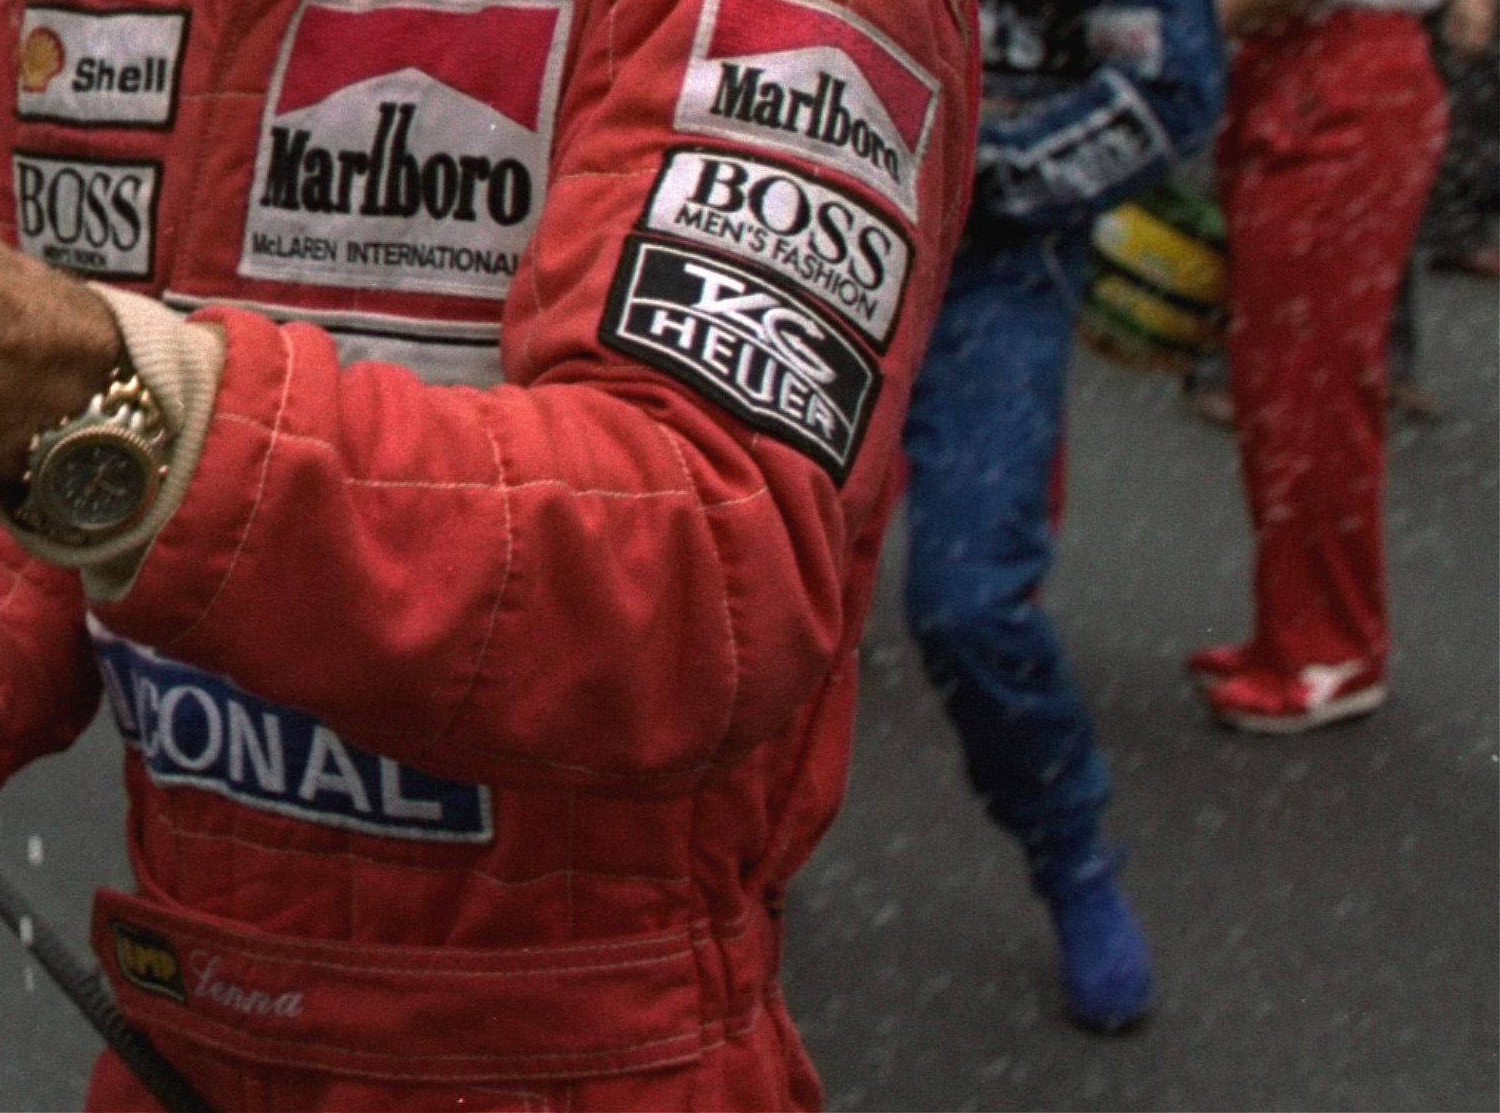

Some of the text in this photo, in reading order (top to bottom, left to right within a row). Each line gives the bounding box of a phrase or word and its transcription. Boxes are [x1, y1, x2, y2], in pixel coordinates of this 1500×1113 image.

[71, 56, 167, 94] Shell
[708, 61, 902, 183] Marlboro
[17, 161, 142, 253] BOSS
[259, 102, 534, 227] Marlboro
[687, 159, 893, 291] BOSS
[674, 206, 879, 321] MEN'S FASHION
[649, 308, 836, 440] HEUER
